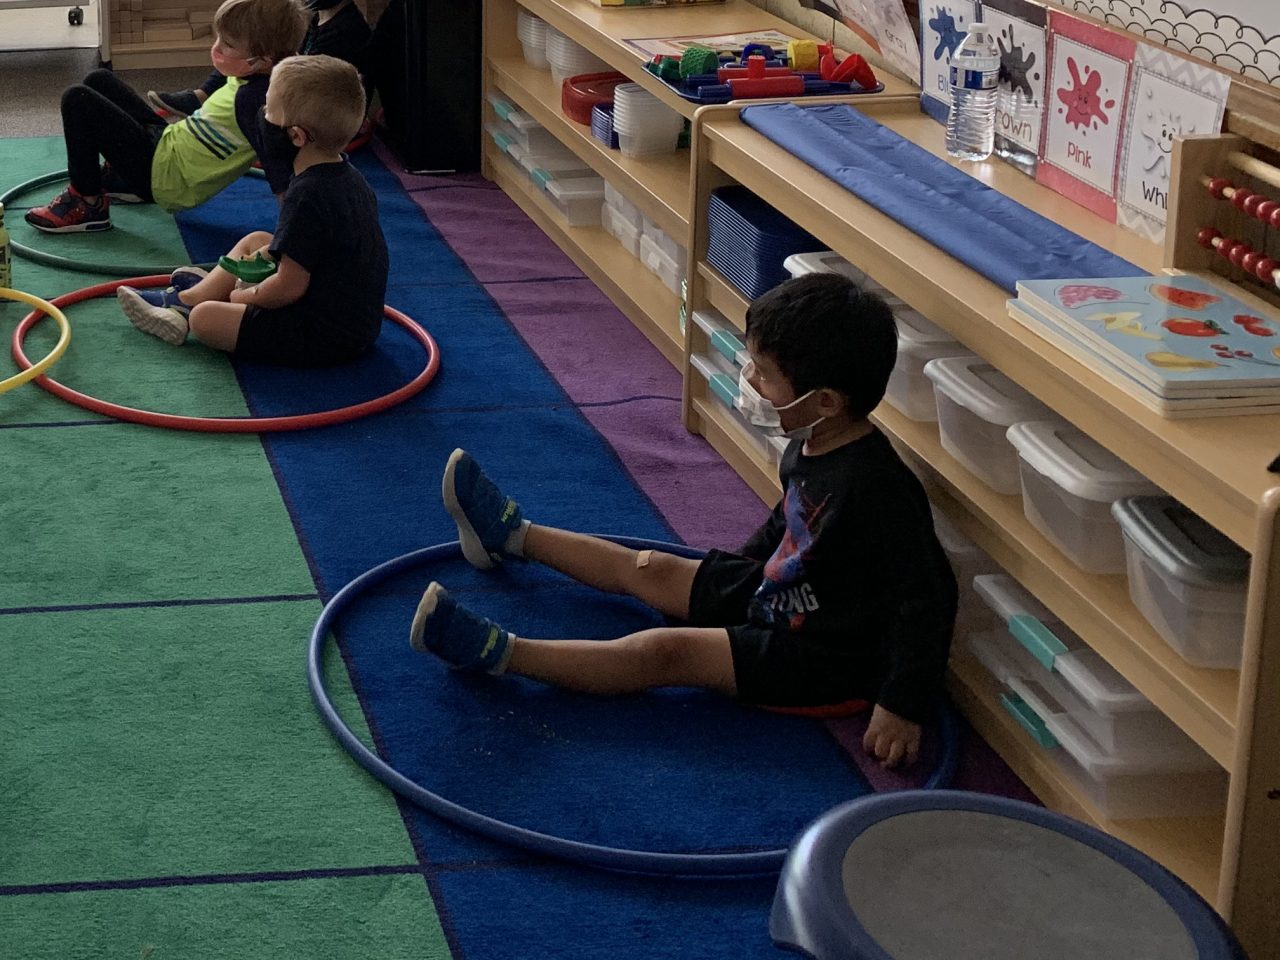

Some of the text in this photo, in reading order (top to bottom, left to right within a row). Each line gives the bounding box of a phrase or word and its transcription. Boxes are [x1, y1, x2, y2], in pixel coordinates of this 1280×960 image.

[937, 73, 949, 94] Bl
[994, 106, 1033, 143] rown
[1141, 180, 1168, 211] Whi
